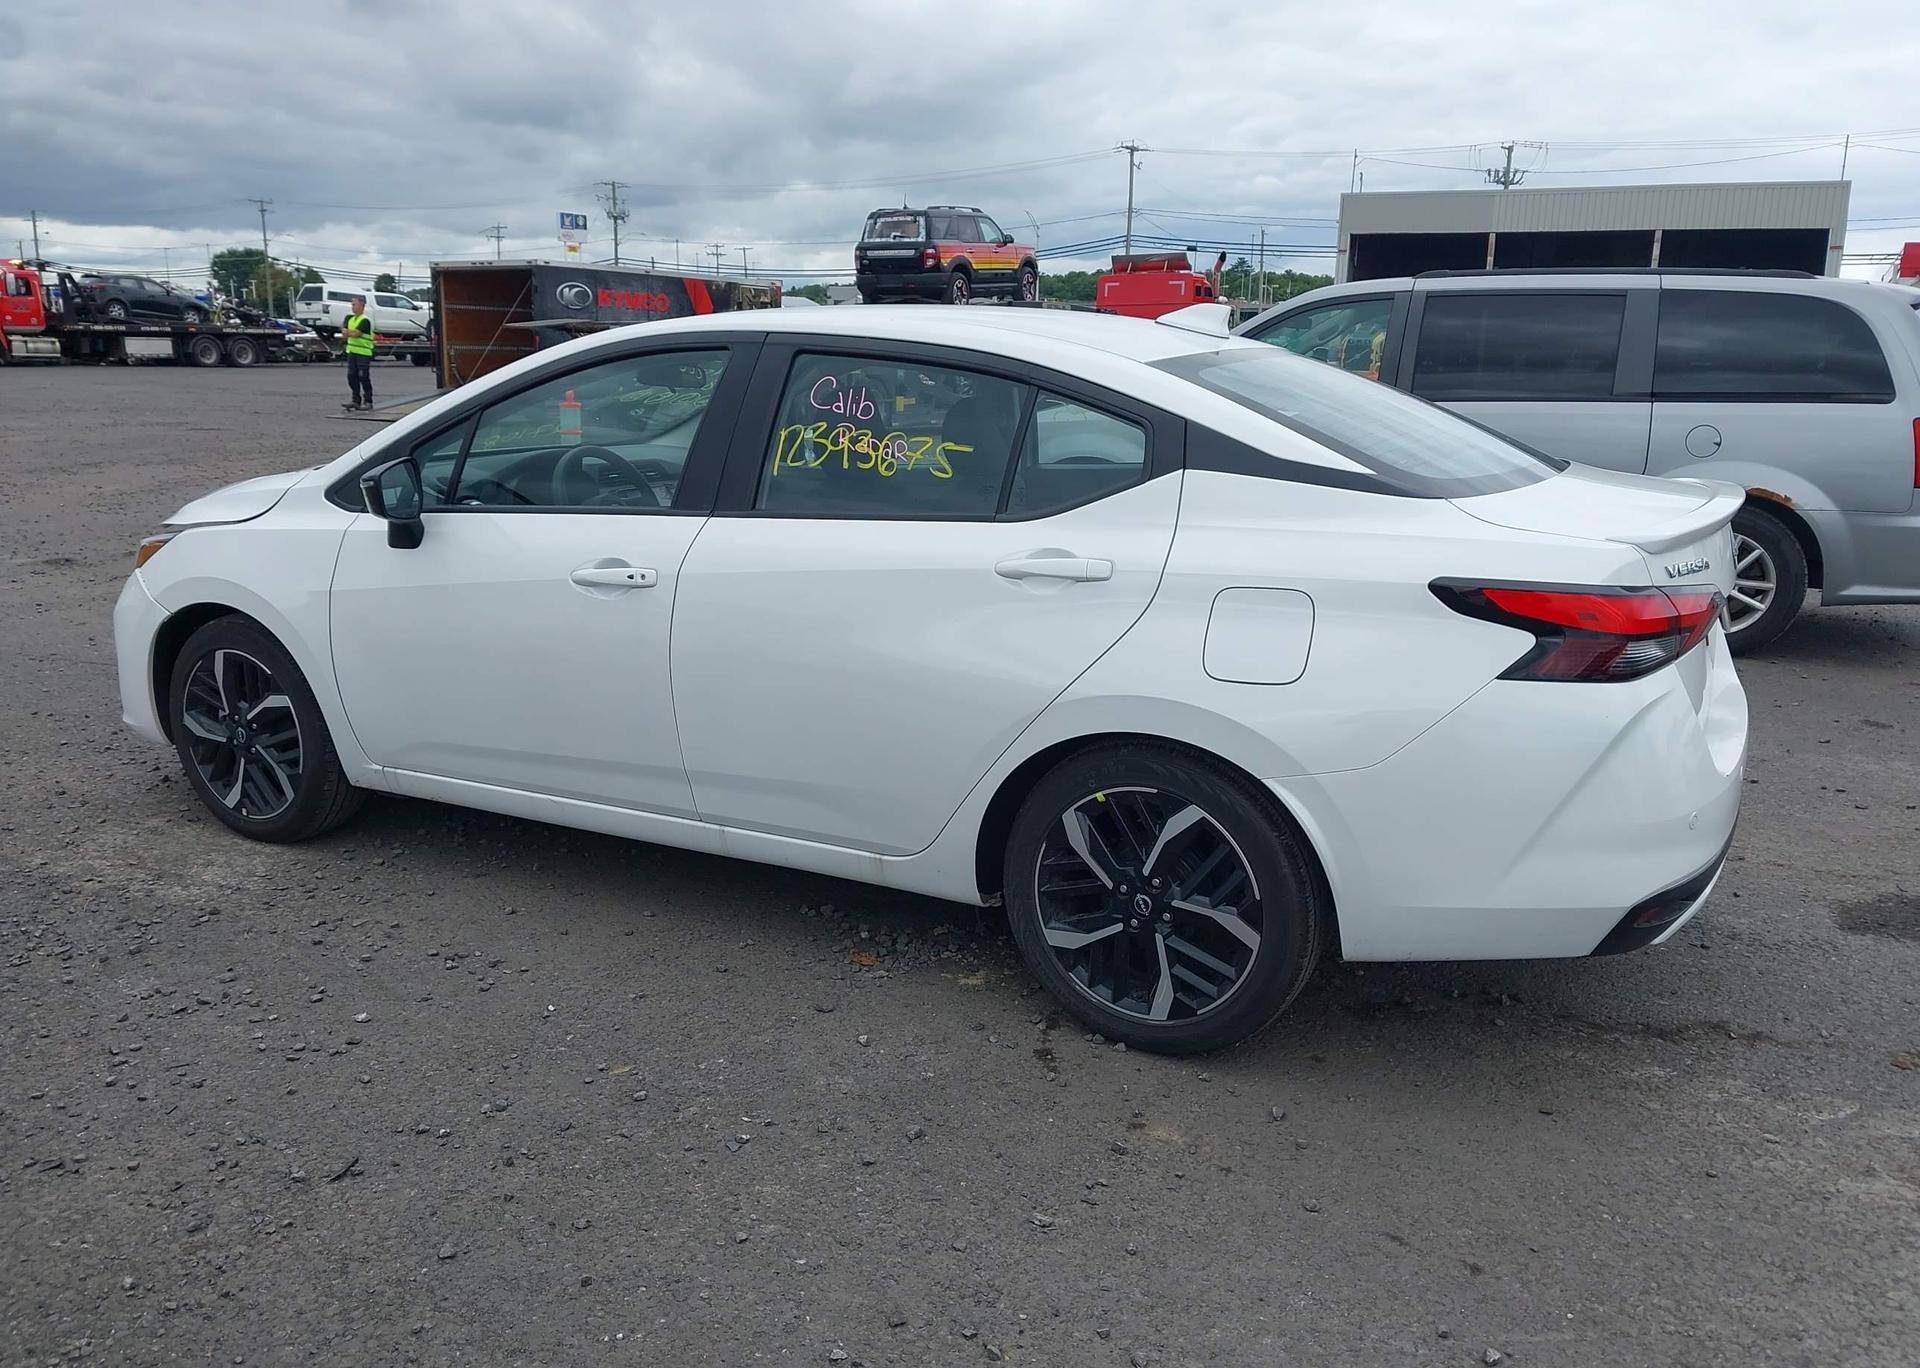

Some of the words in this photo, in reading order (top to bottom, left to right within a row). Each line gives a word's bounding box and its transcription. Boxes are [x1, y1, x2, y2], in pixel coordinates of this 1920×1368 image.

[597, 287, 671, 314] KYMCO
[810, 375, 875, 420] Calib
[1664, 557, 1711, 579] VERSA
